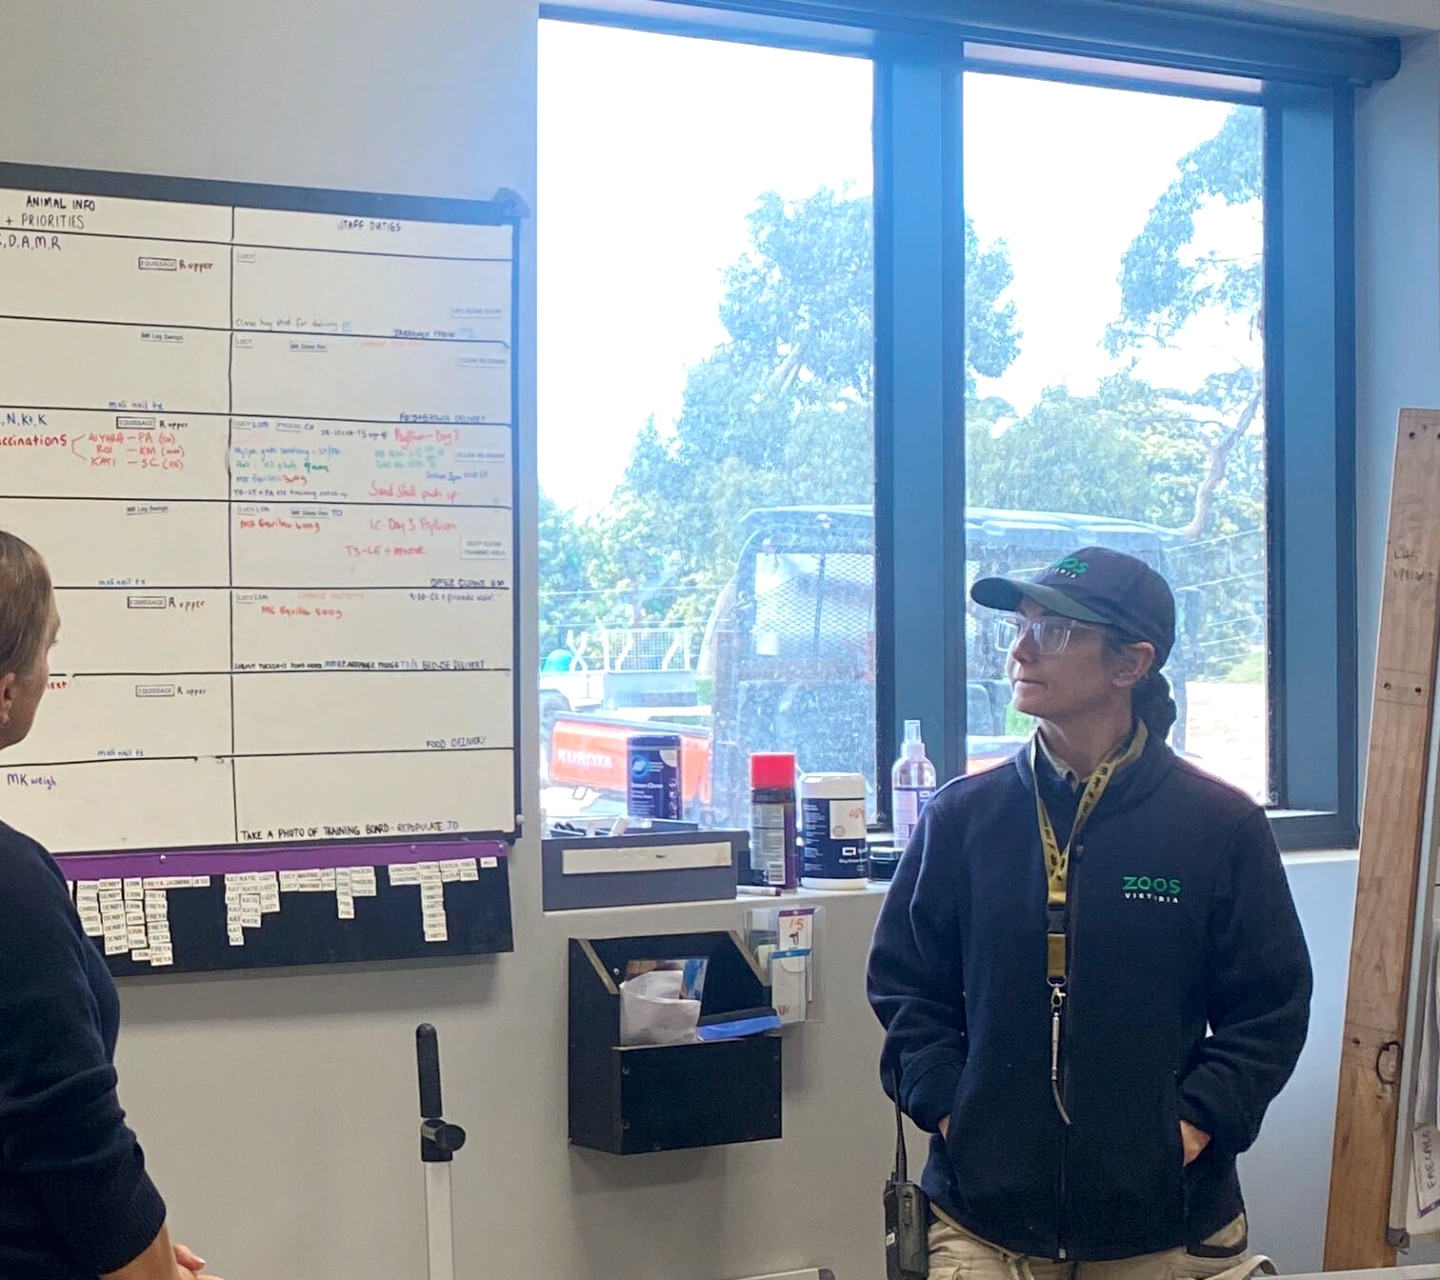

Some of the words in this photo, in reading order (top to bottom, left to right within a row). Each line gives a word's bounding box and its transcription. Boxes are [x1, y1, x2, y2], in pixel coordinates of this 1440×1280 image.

[26, 195, 66, 209] ANIMAL
[73, 200, 96, 212] INFO
[21, 214, 85, 230] PRIORITIES
[338, 218, 365, 231] STAFF
[370, 221, 402, 233] DUTIES
[557, 750, 613, 769] KUBOTA
[7, 772, 28, 787] MK
[241, 829, 263, 841] TAKE
[266, 830, 274, 839] A
[278, 827, 305, 839] PHOTO
[307, 827, 317, 837] OF
[323, 826, 360, 837] TRAINING
[1122, 875, 1181, 896] ZOOS
